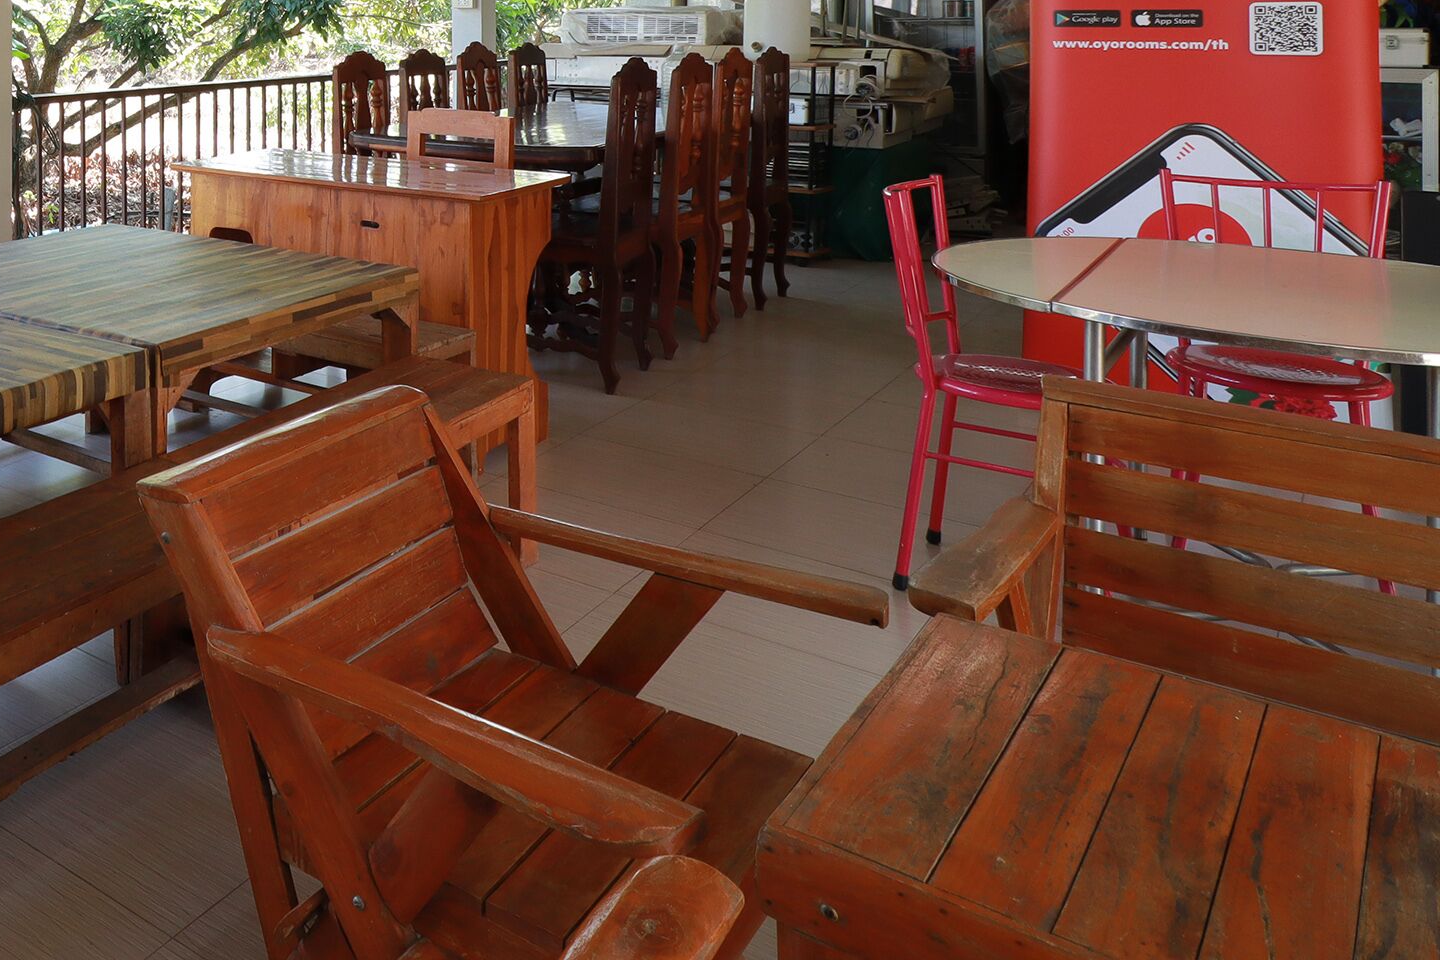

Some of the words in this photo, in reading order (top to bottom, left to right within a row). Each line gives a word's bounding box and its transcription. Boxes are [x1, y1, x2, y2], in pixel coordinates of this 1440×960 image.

[1071, 15, 1101, 25] Google
[1101, 16, 1119, 24] play
[1173, 17, 1197, 25] Store
[1052, 39, 1229, 51] www.oyorooms.com/th
